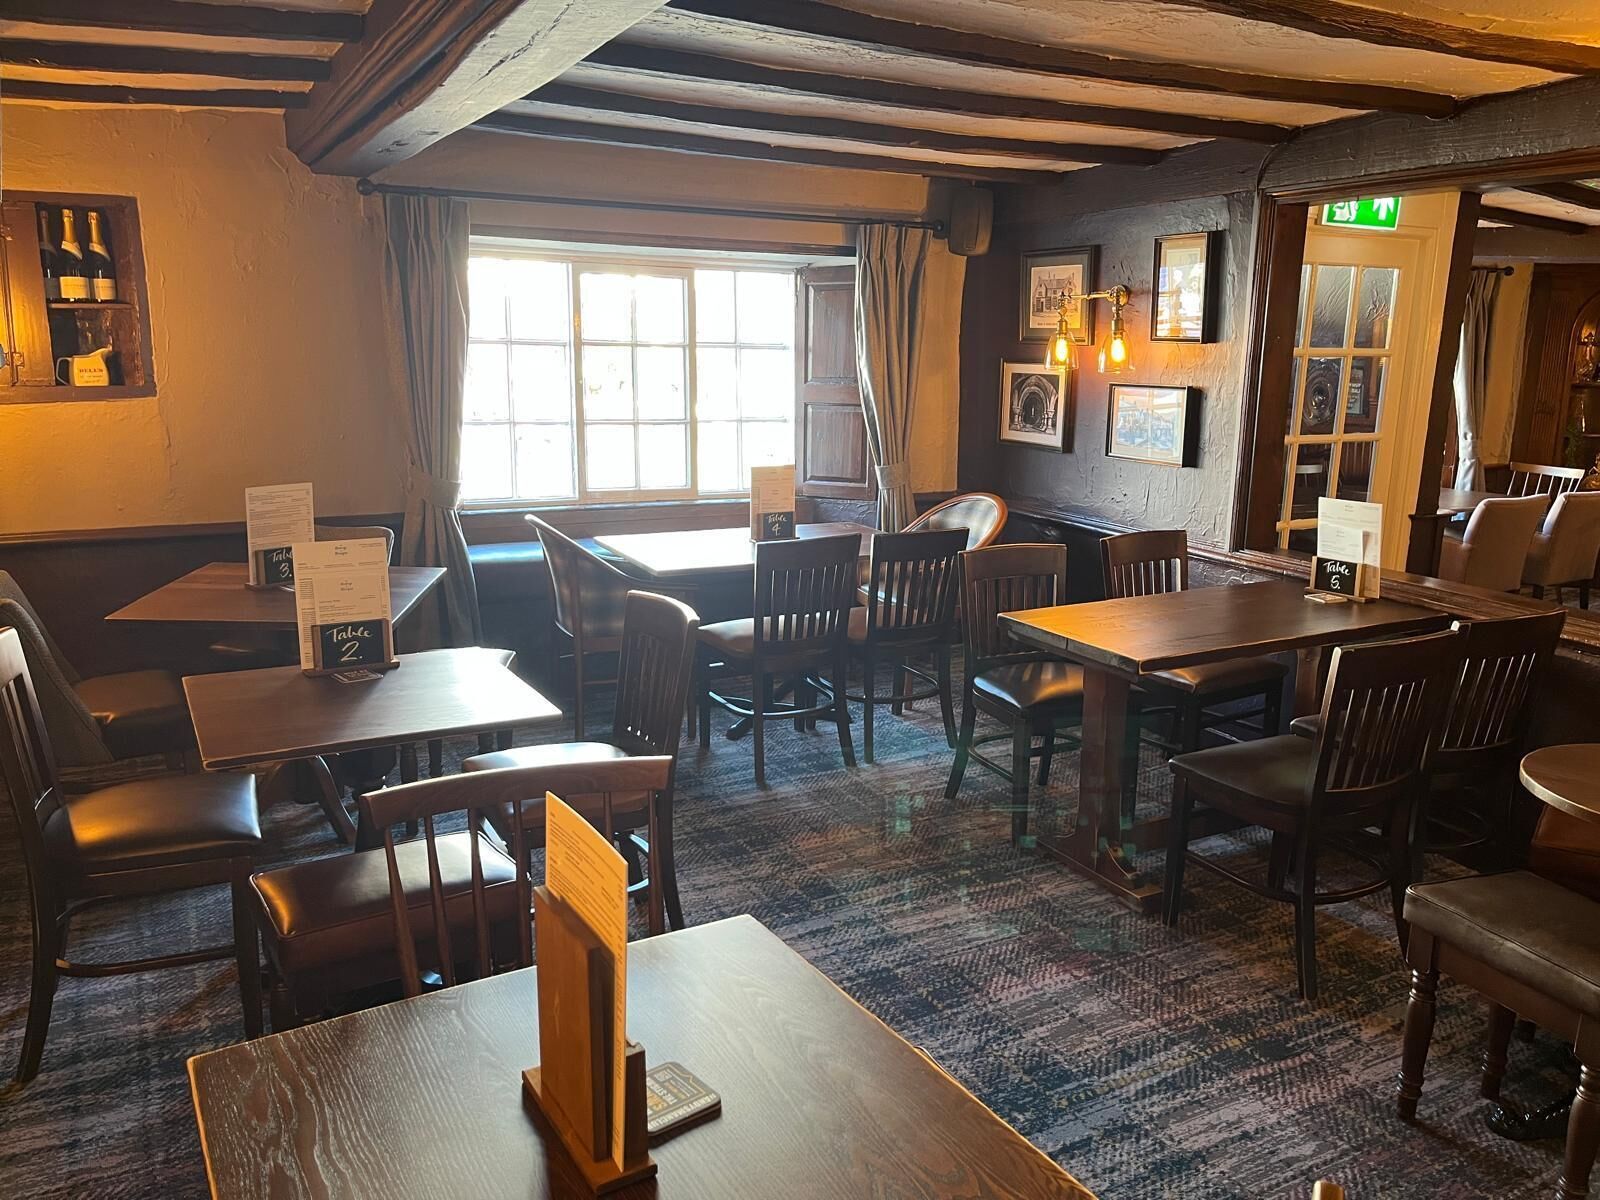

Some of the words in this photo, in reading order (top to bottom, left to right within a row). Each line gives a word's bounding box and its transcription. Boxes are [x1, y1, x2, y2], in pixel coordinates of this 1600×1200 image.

[767, 513, 788, 524] Table
[1323, 560, 1351, 576] Table
[326, 625, 374, 642] Table
